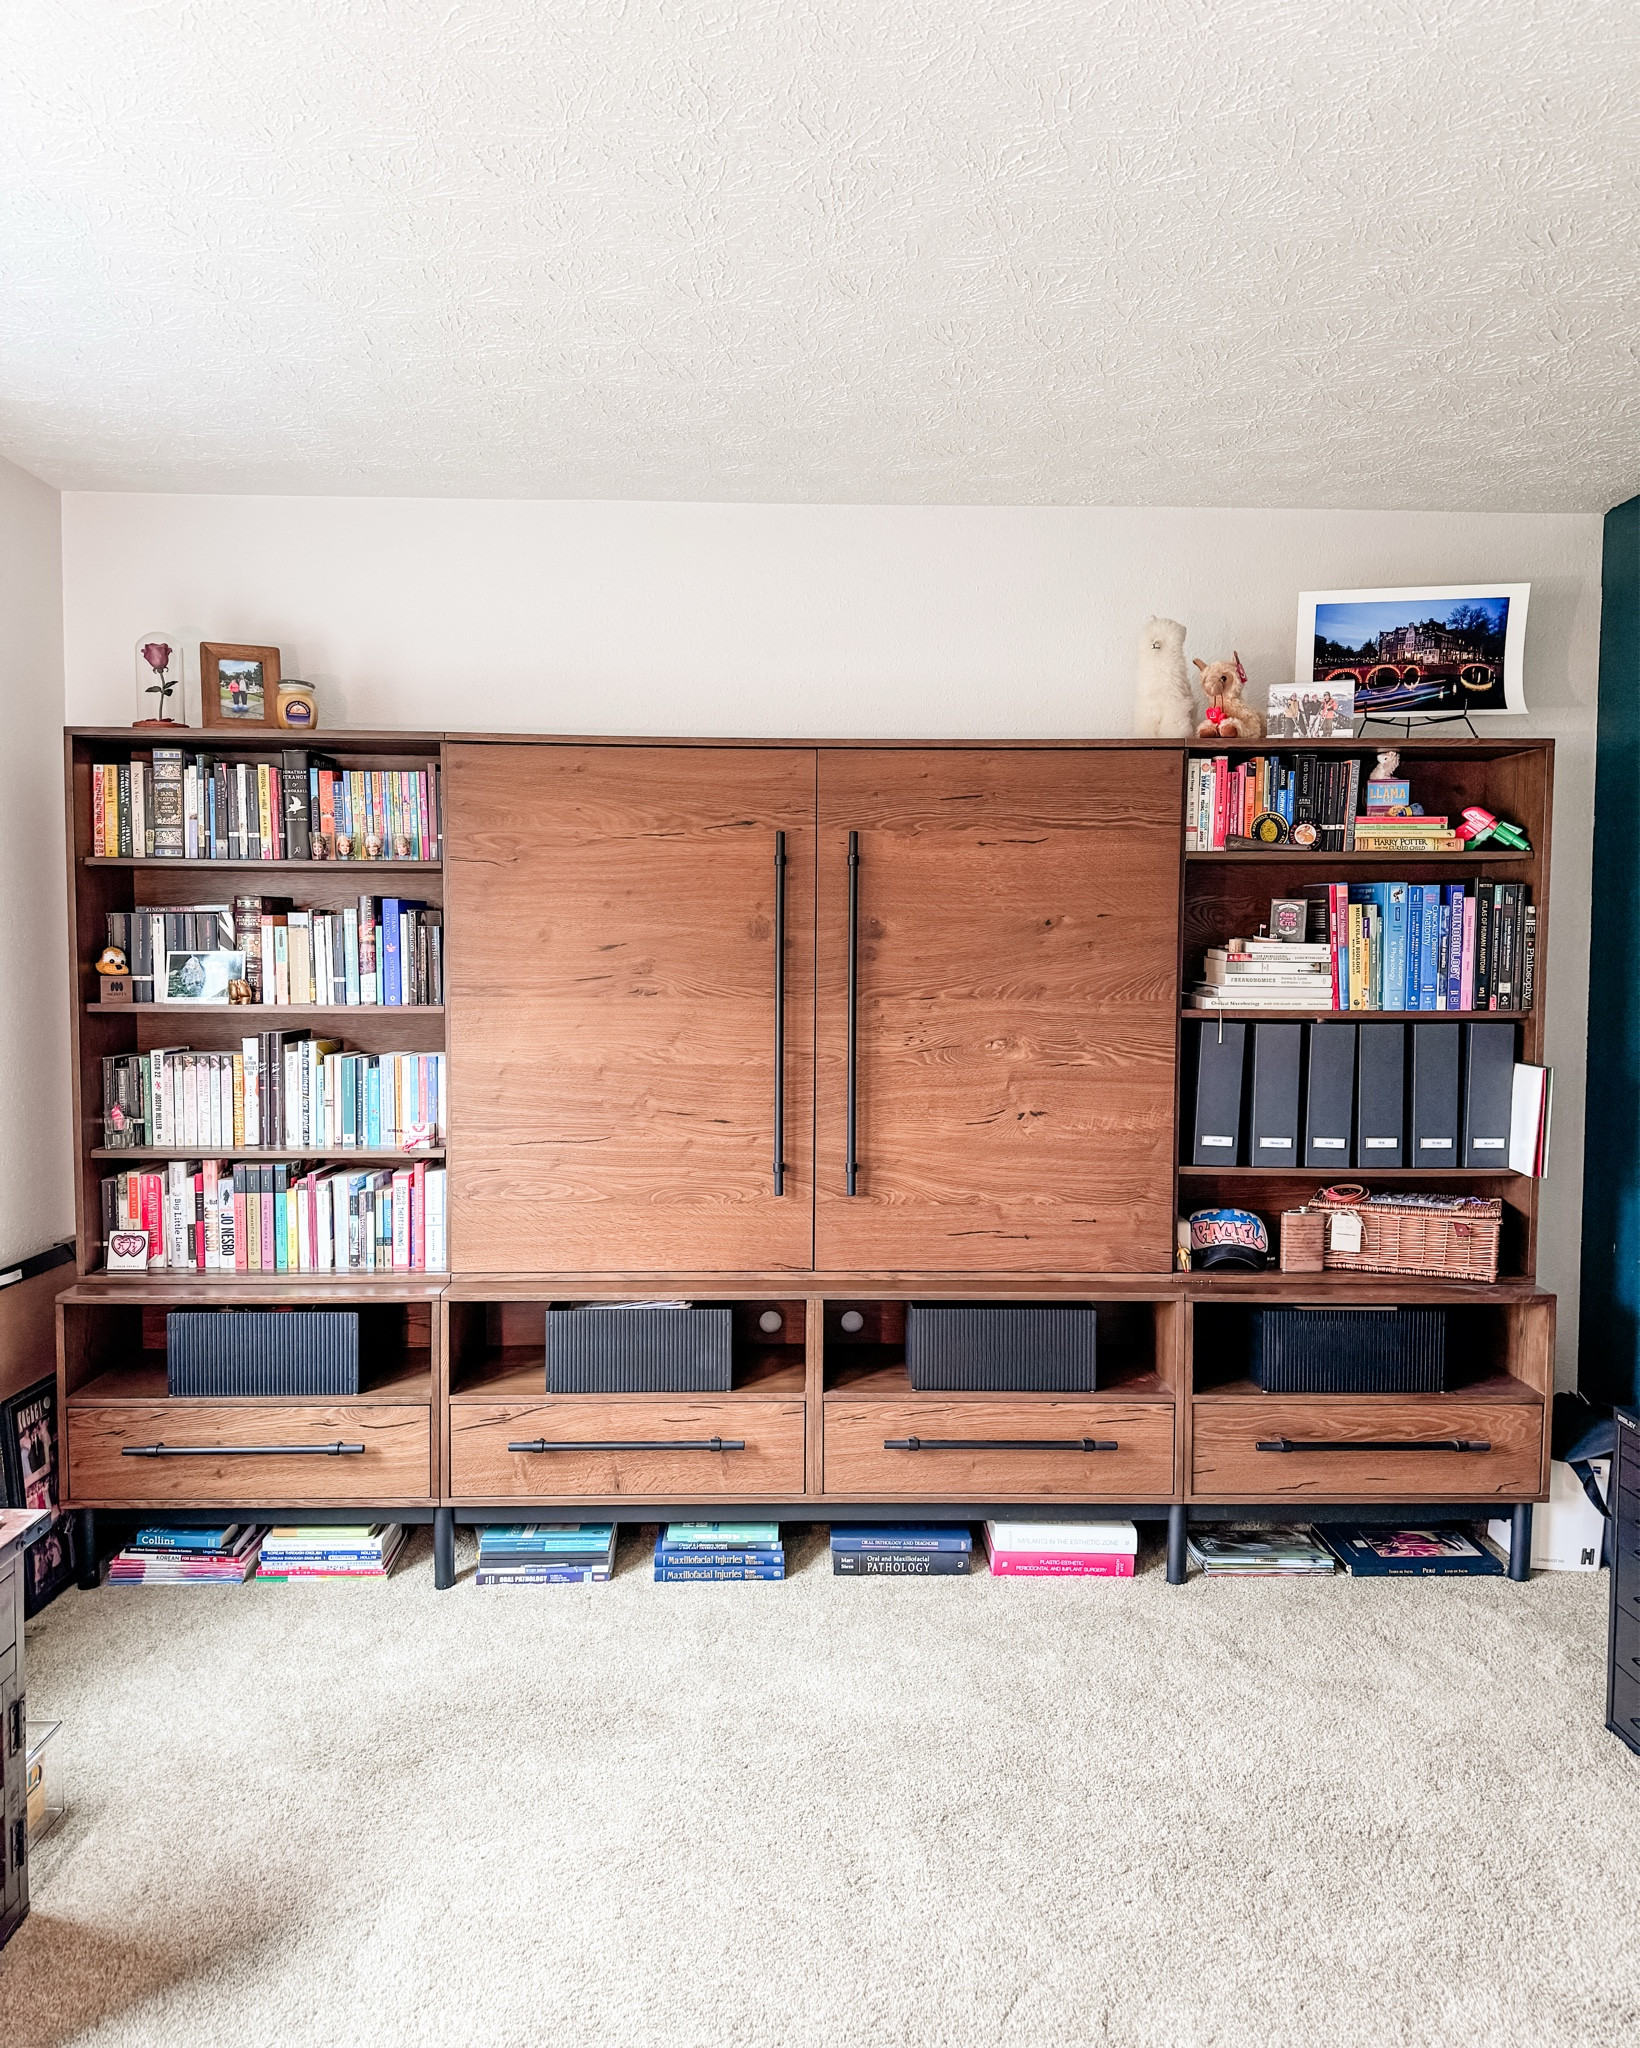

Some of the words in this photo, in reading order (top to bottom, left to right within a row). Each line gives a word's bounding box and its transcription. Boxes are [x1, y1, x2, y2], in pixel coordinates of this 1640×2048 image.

[1350, 763, 1360, 796] ARTEMIS
[1370, 787, 1406, 799] LLAMA
[1400, 838, 1428, 846] POTTER
[1422, 909, 1432, 946] Anatomy
[1450, 892, 1462, 980] IMMUNOBIOLOGY
[1523, 947, 1534, 1000] Philosophy
[234, 1059, 242, 1082] CARL
[234, 1092, 243, 1134] HIAASEN
[148, 1192, 157, 1212] GONE
[173, 1198, 181, 1210] Big
[205, 1207, 218, 1219] JO
[221, 1213, 234, 1225] JO
[149, 1223, 157, 1243] WIND
[205, 1222, 218, 1252] NESBO
[221, 1228, 234, 1255] NESBO
[1193, 1222, 1266, 1250] RACHEL
[1617, 1414, 1637, 1430] BISLEY
[141, 1536, 175, 1545] Collins
[668, 1556, 713, 1565] Maxillofacial
[715, 1555, 743, 1565] Injuries
[867, 1562, 930, 1572] PATHOLOGY
[667, 1570, 713, 1579] Maxillofacial
[714, 1570, 742, 1580] Injuries
